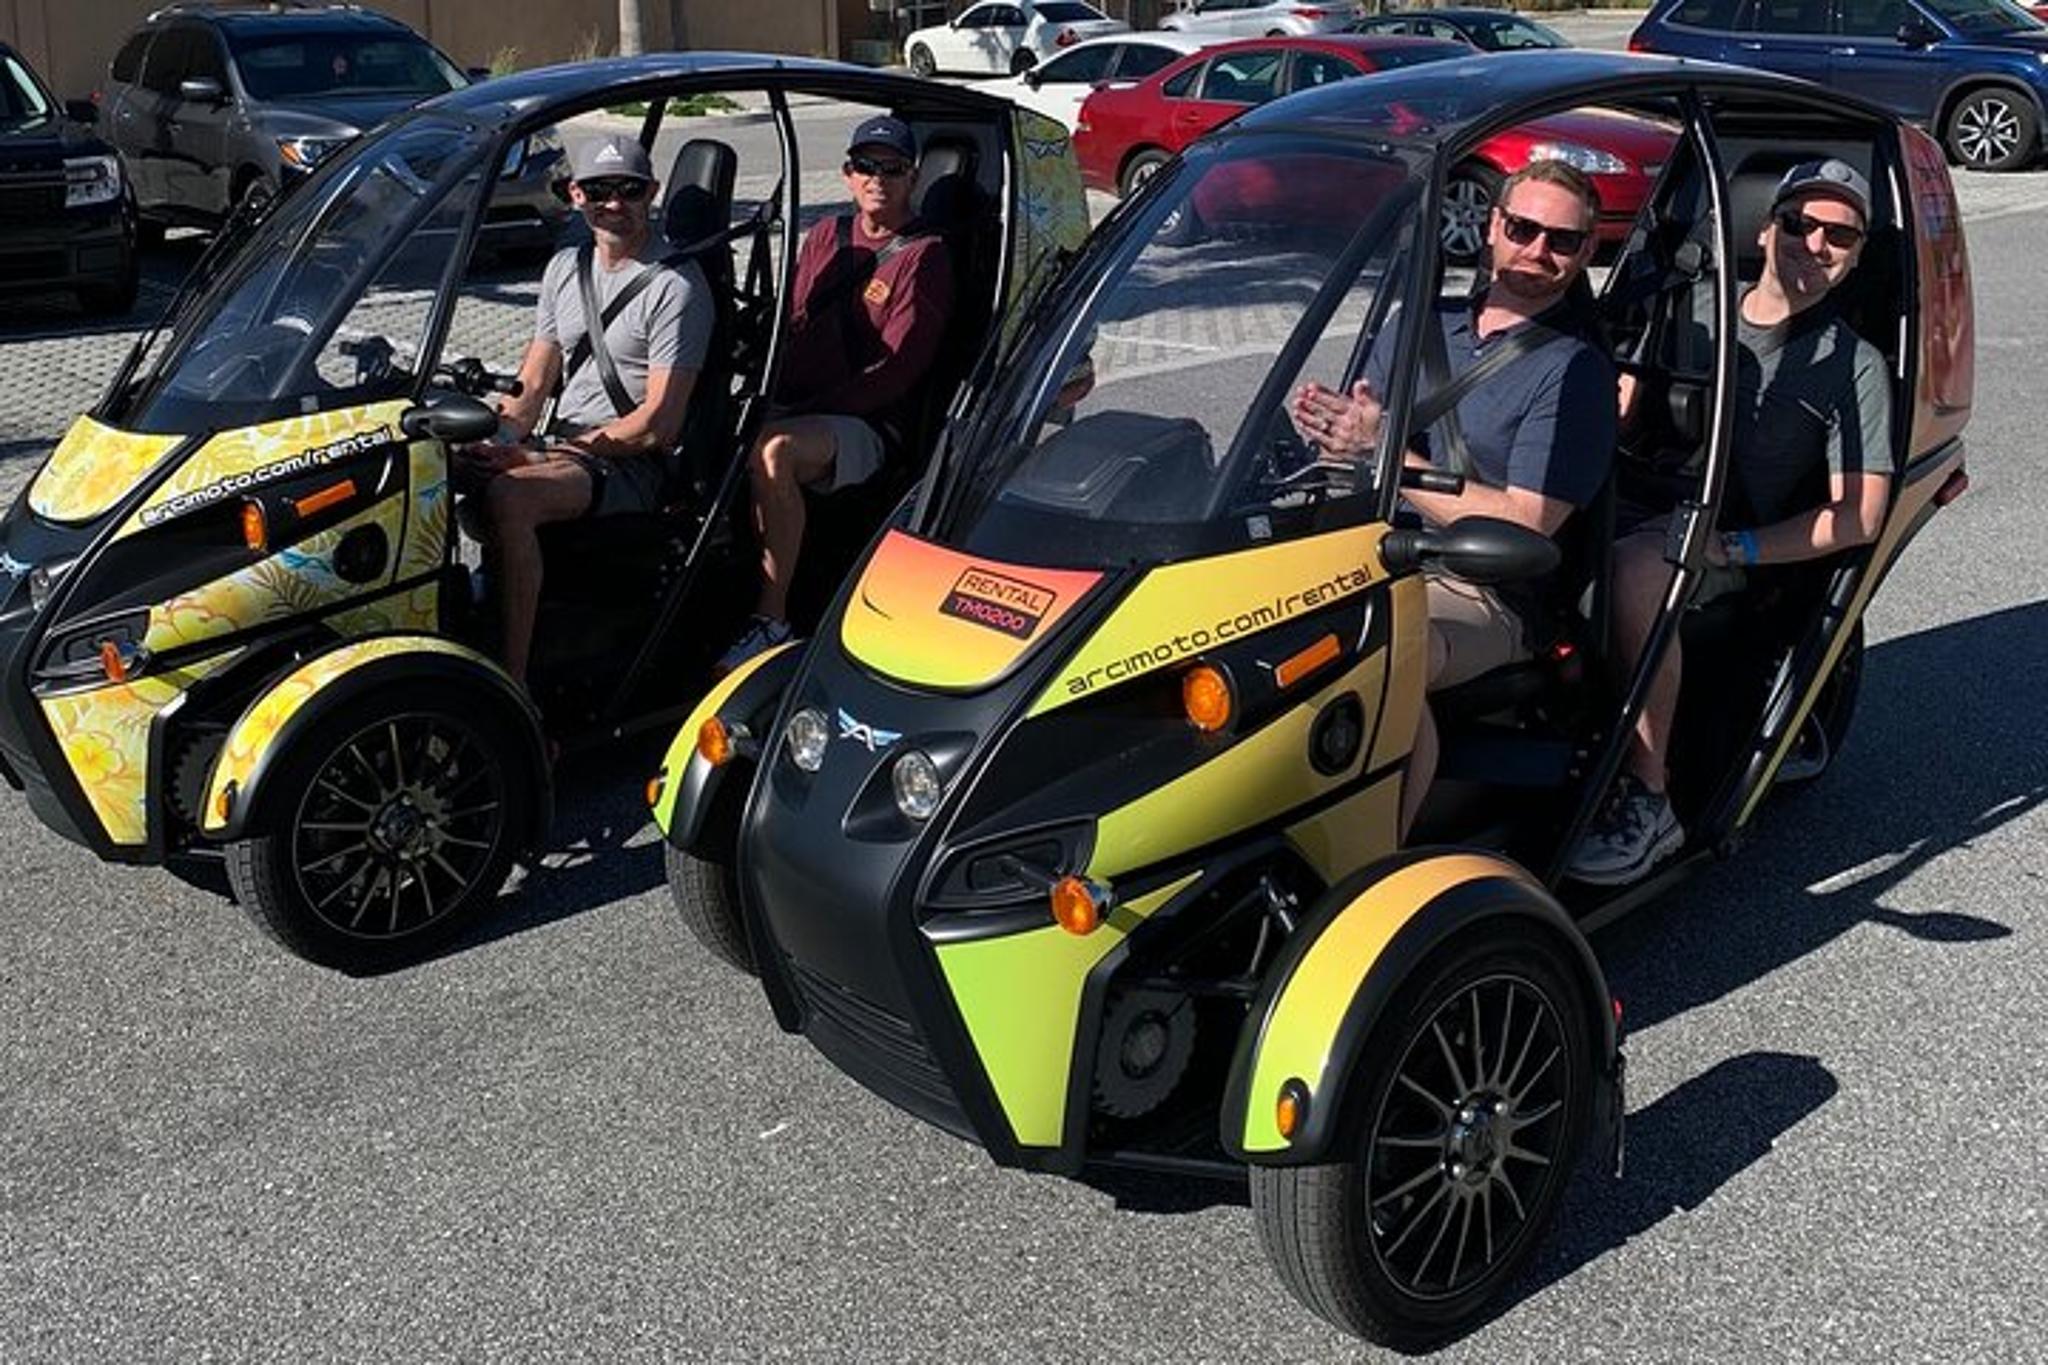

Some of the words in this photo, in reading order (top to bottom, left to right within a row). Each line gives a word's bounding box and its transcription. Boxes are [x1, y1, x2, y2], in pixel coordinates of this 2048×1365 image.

[142, 426, 392, 526] arcimoto.com/rental
[962, 574, 1041, 611] RENTAL
[1066, 565, 1374, 695] arcimoto.com/rental
